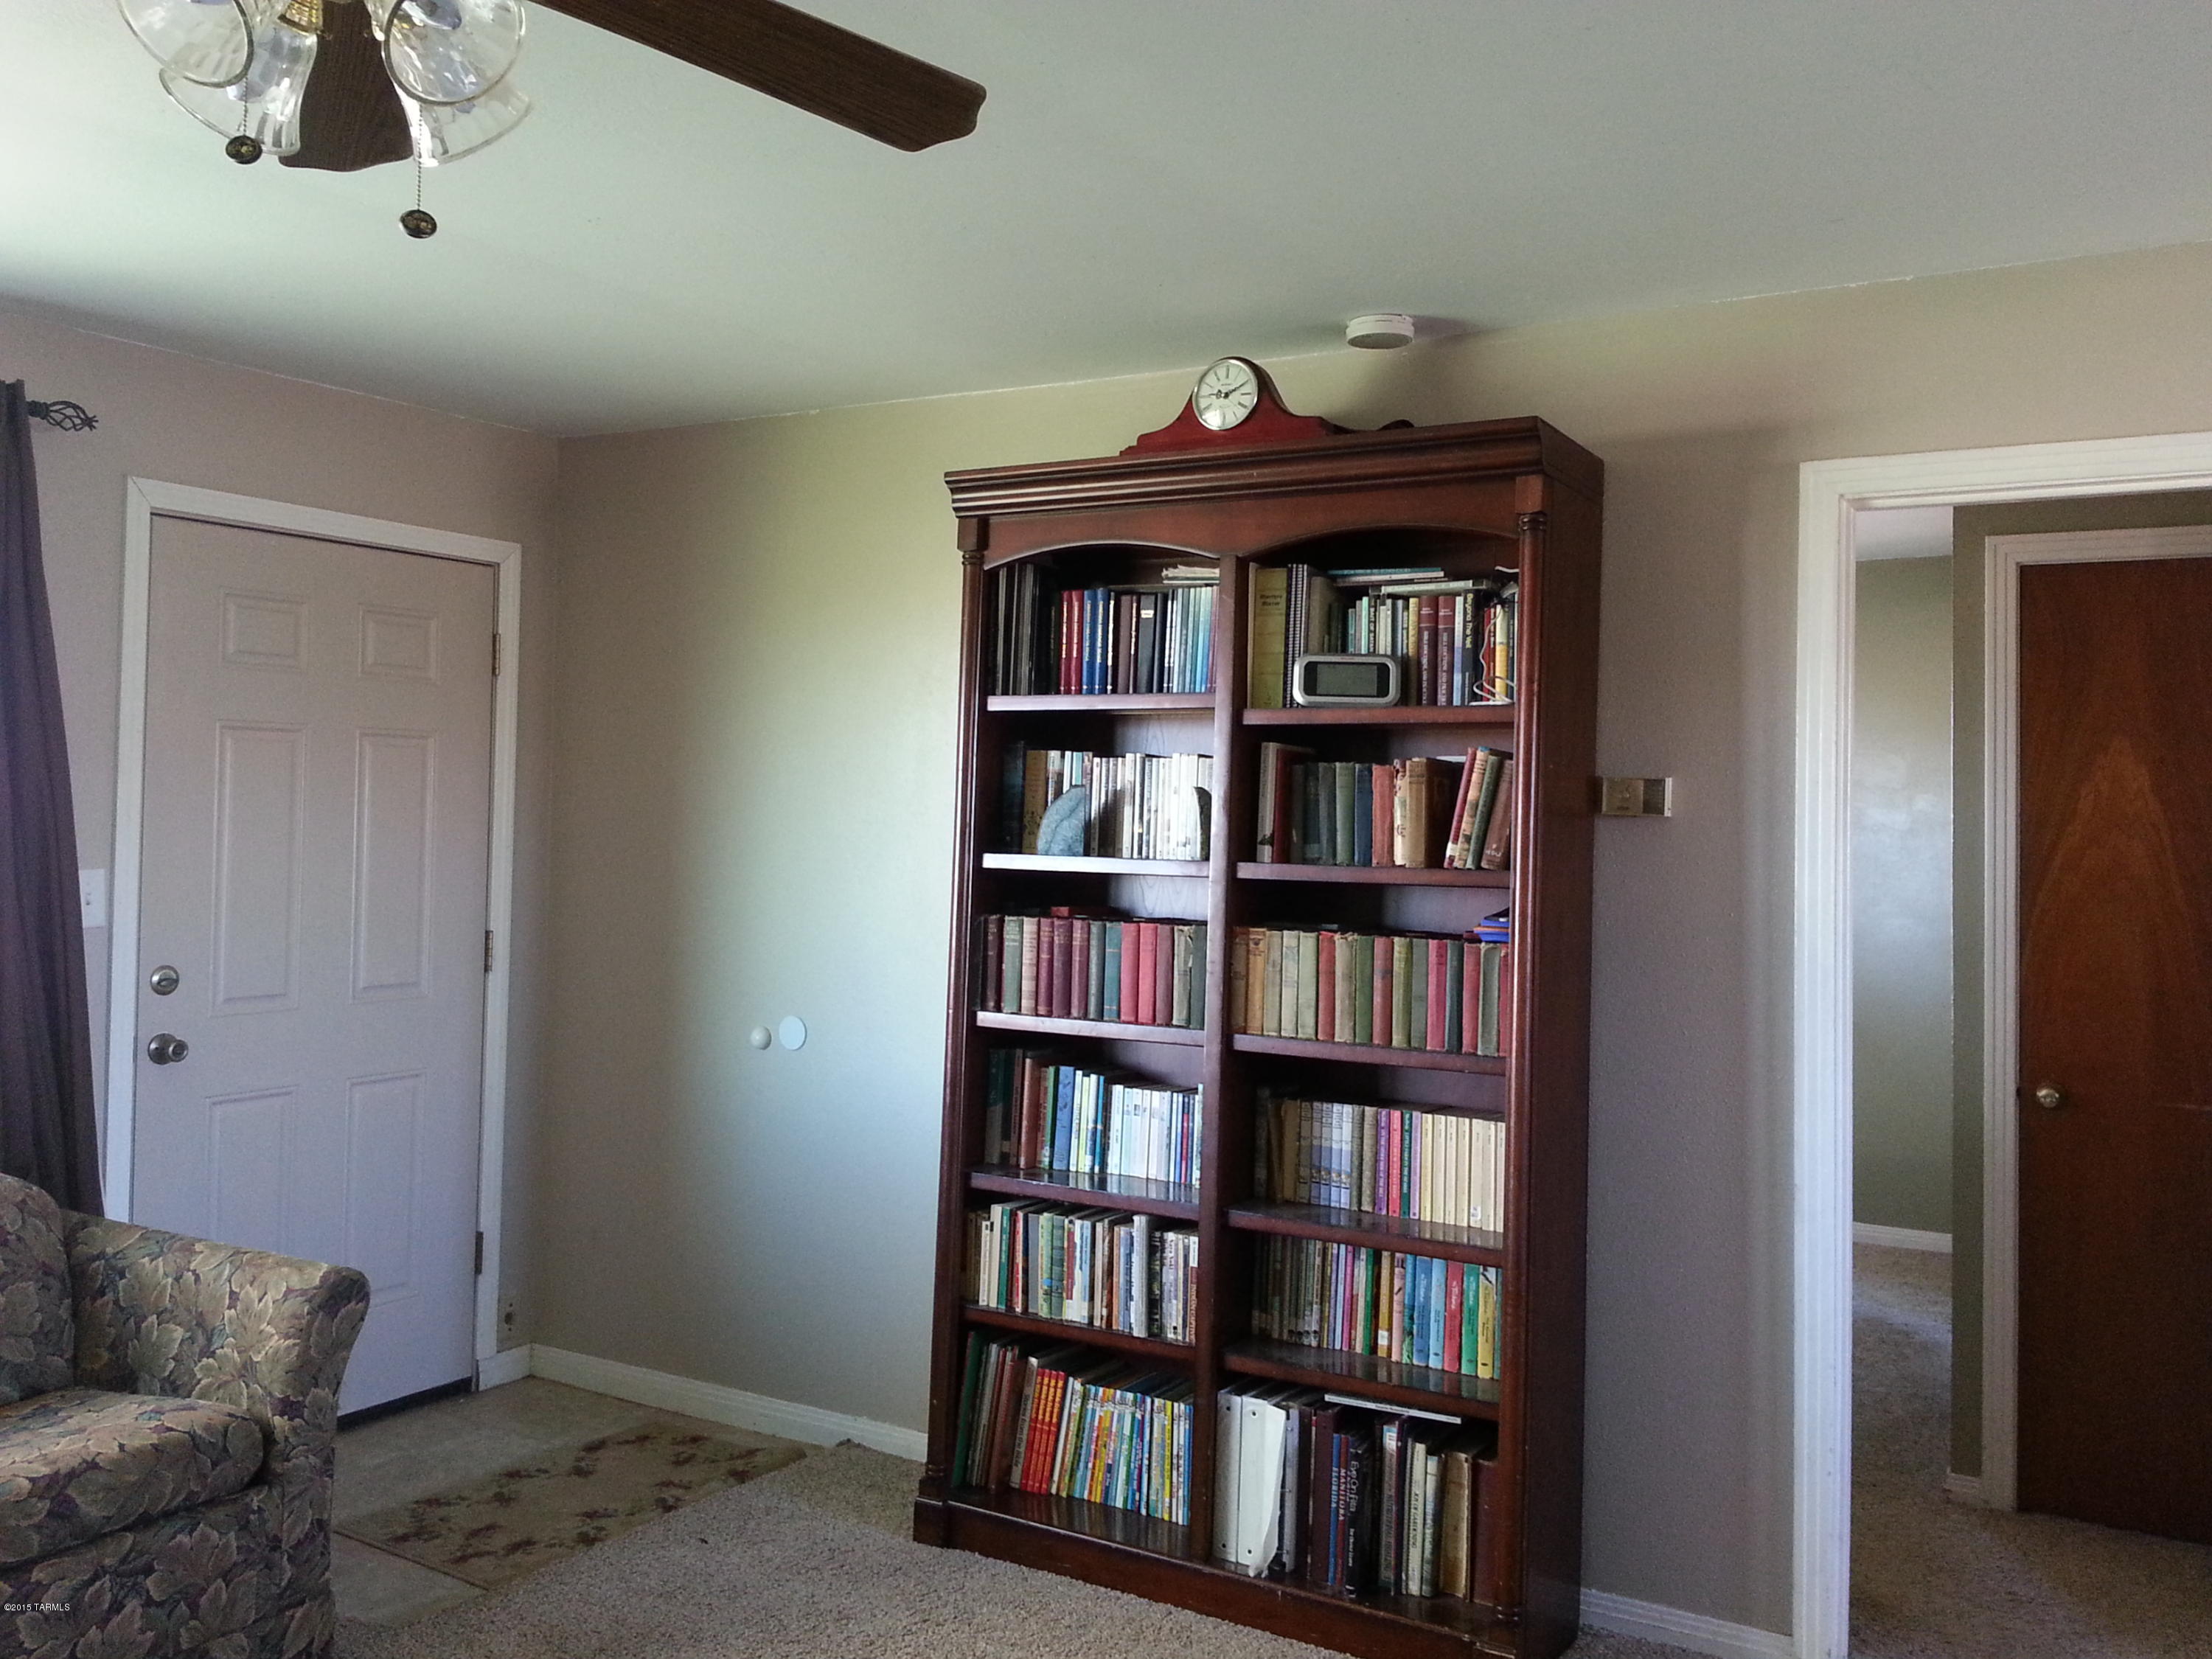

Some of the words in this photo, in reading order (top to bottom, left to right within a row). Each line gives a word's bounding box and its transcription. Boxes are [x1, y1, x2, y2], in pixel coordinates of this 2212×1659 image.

[1465, 594, 1473, 621] Beyond
[1370, 622, 1374, 630] OF
[1349, 1461, 1359, 1478] Eye
[1338, 1468, 1346, 1520] MANITOBA
[1350, 1479, 1359, 1493] On
